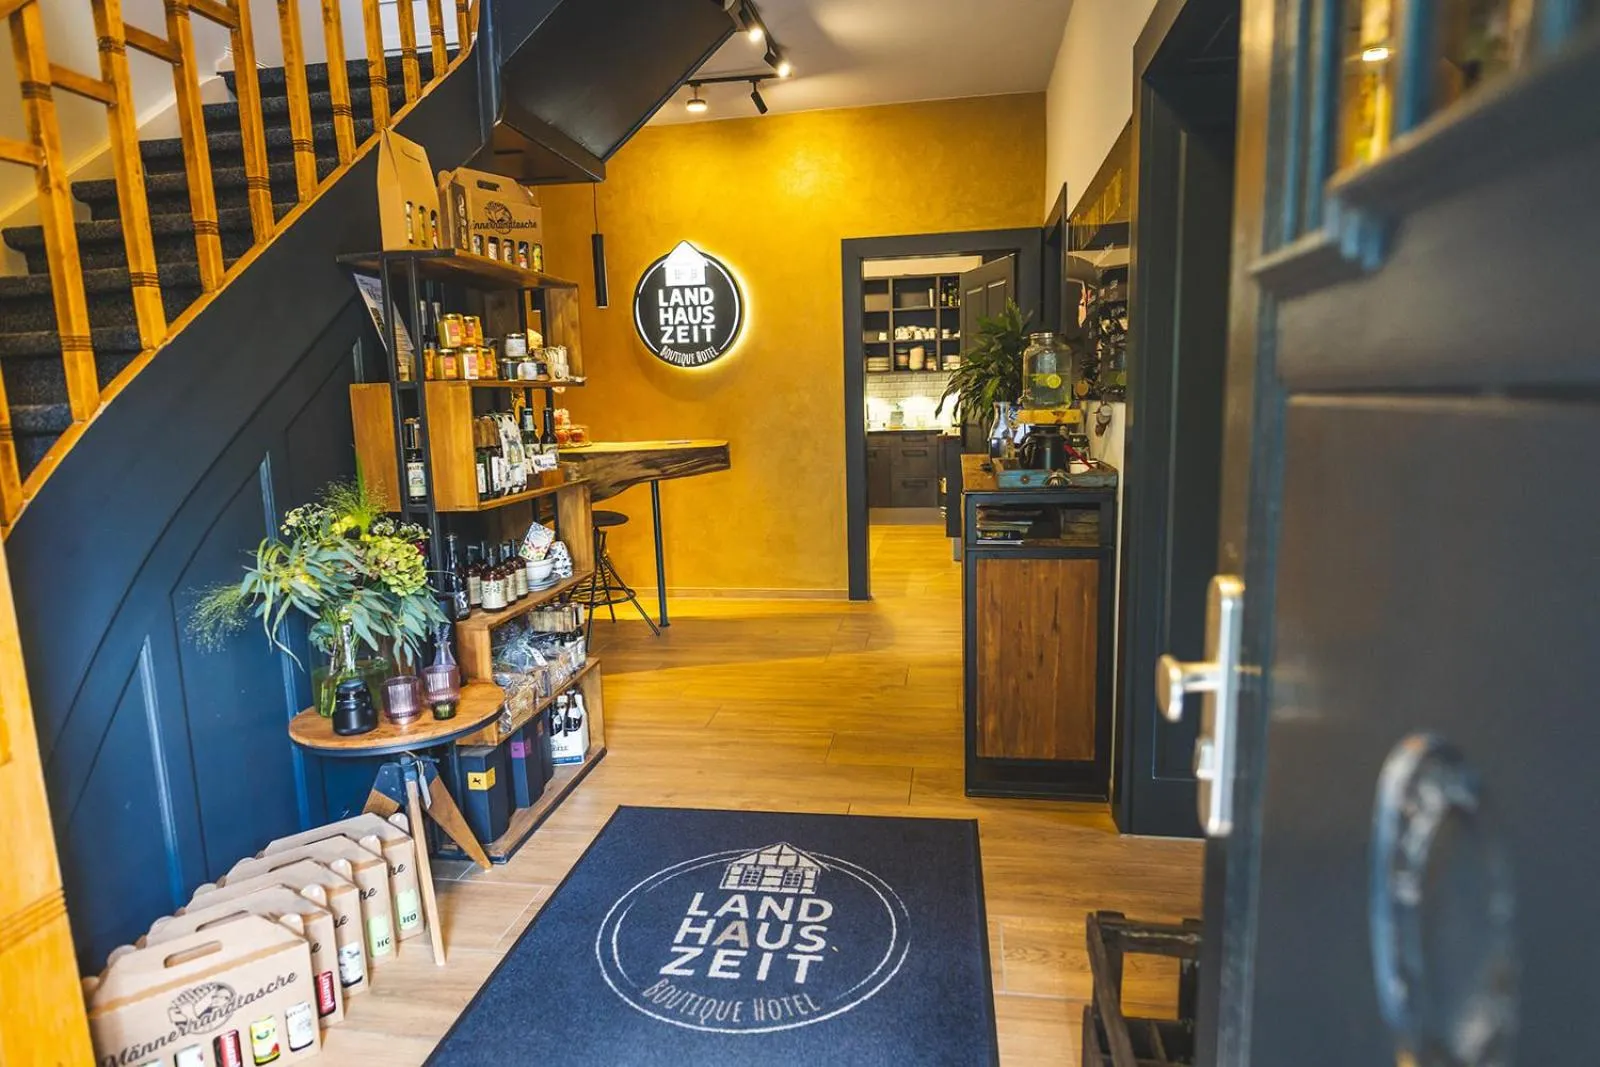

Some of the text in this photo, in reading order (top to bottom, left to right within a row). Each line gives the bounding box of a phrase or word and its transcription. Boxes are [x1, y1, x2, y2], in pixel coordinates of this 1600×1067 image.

[658, 287, 715, 307] LAND
[658, 305, 715, 326] HAUS
[660, 324, 716, 344] ZEIT
[660, 345, 719, 366] BOUTIQUE HOTEL
[687, 892, 833, 923] LAND
[673, 918, 827, 952] HAUS
[659, 946, 823, 984] ZEIT
[642, 978, 821, 1025] BOUTIQUE HOTEL
